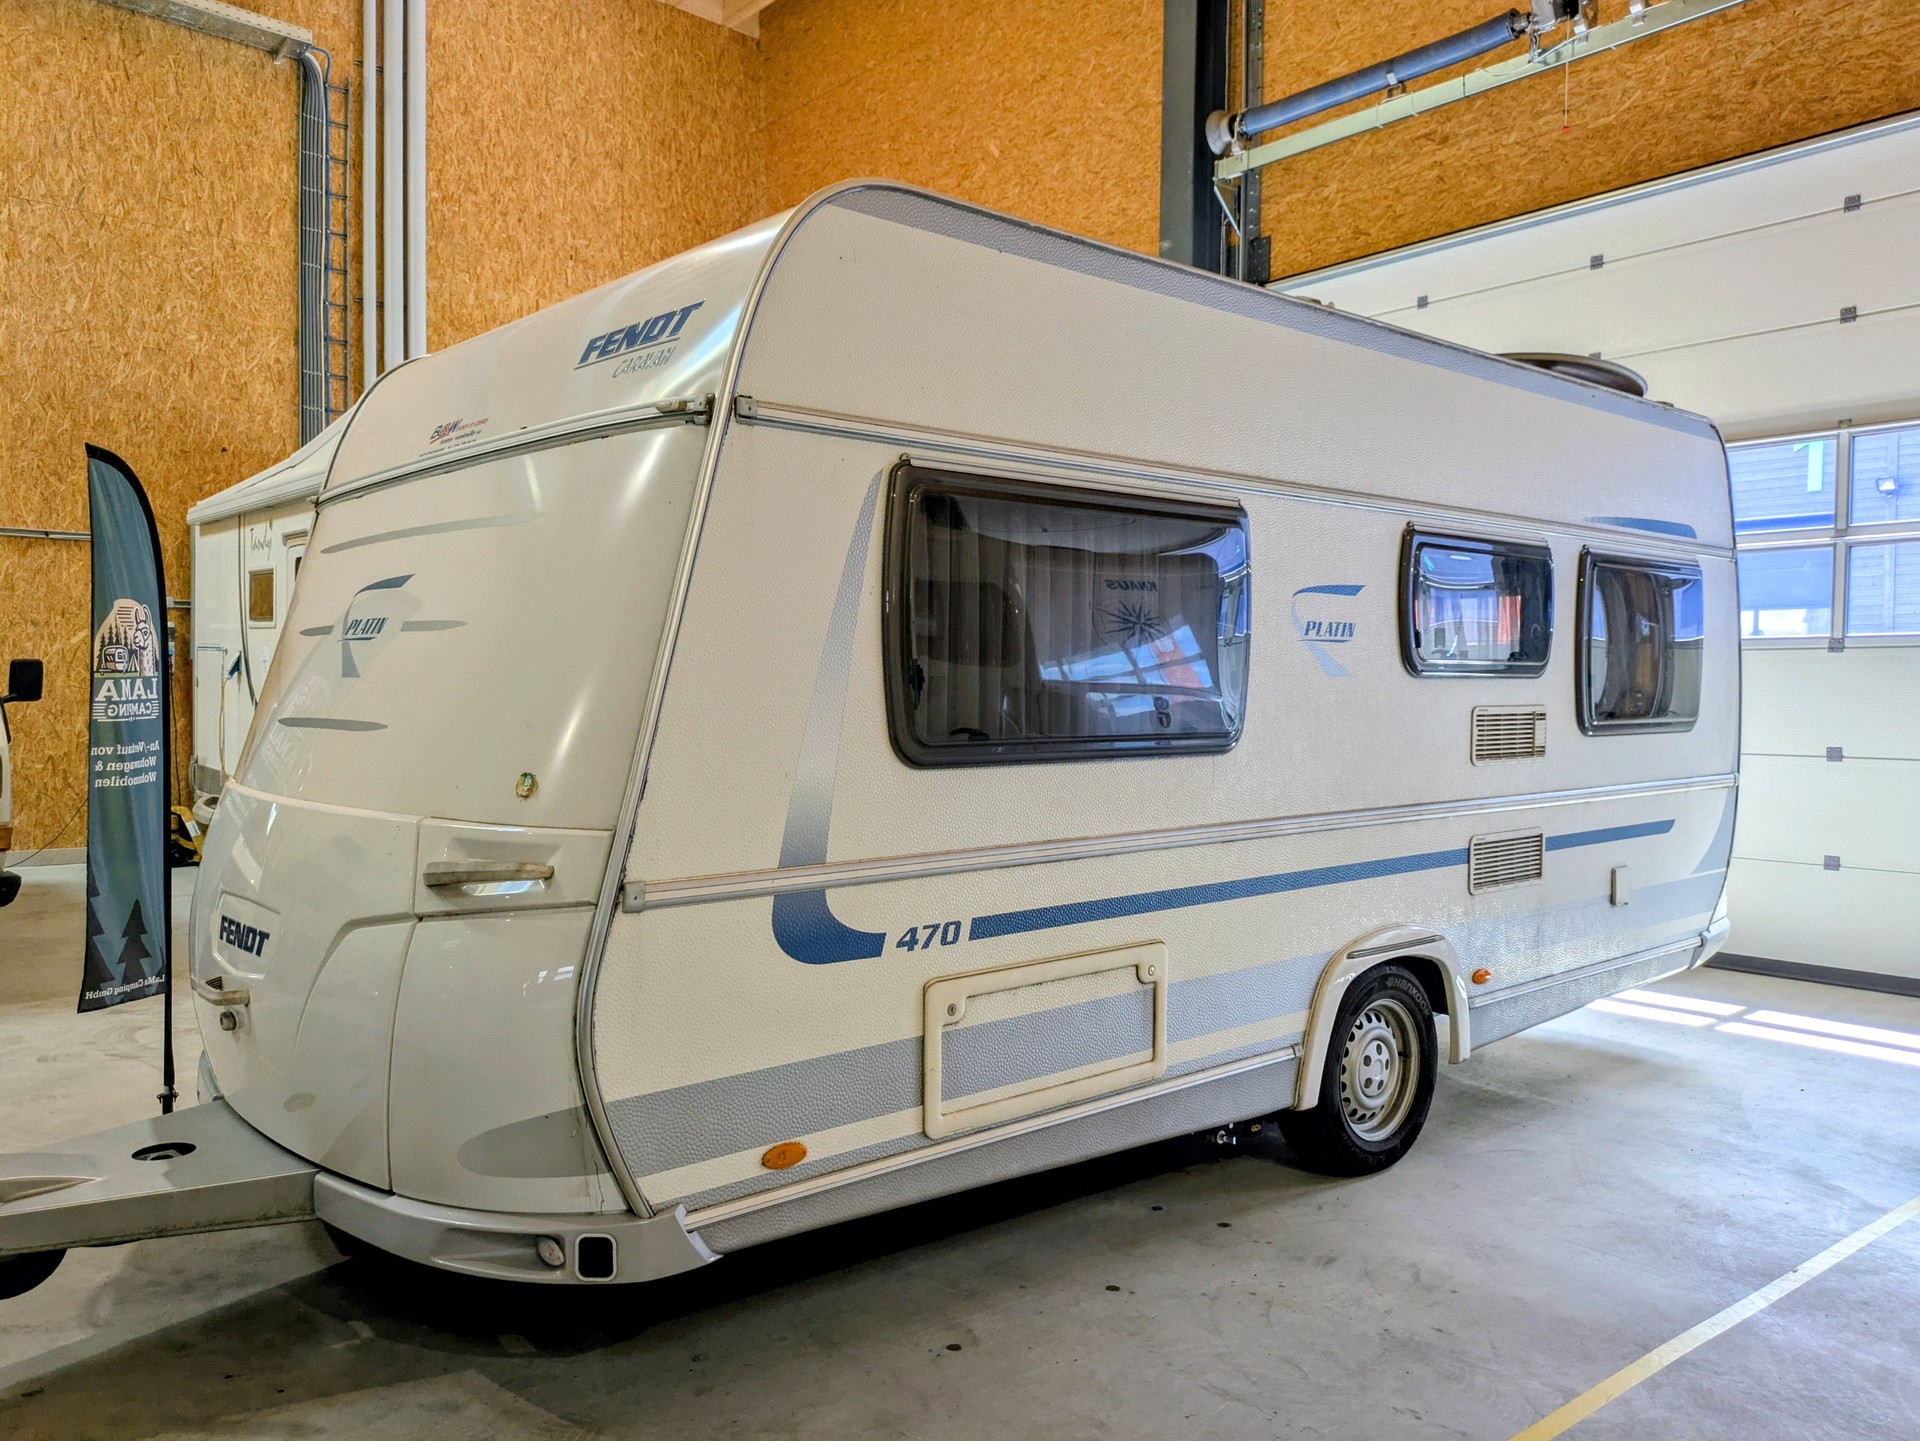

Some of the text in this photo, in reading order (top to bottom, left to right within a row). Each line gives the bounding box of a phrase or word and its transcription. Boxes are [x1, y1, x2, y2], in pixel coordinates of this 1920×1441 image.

[578, 299, 706, 366] FENDT
[612, 346, 677, 379] CARAVAN
[344, 617, 390, 636] PLATIN
[1303, 620, 1357, 638] PLATIN
[219, 914, 271, 958] FENDT
[896, 920, 962, 952] 470
